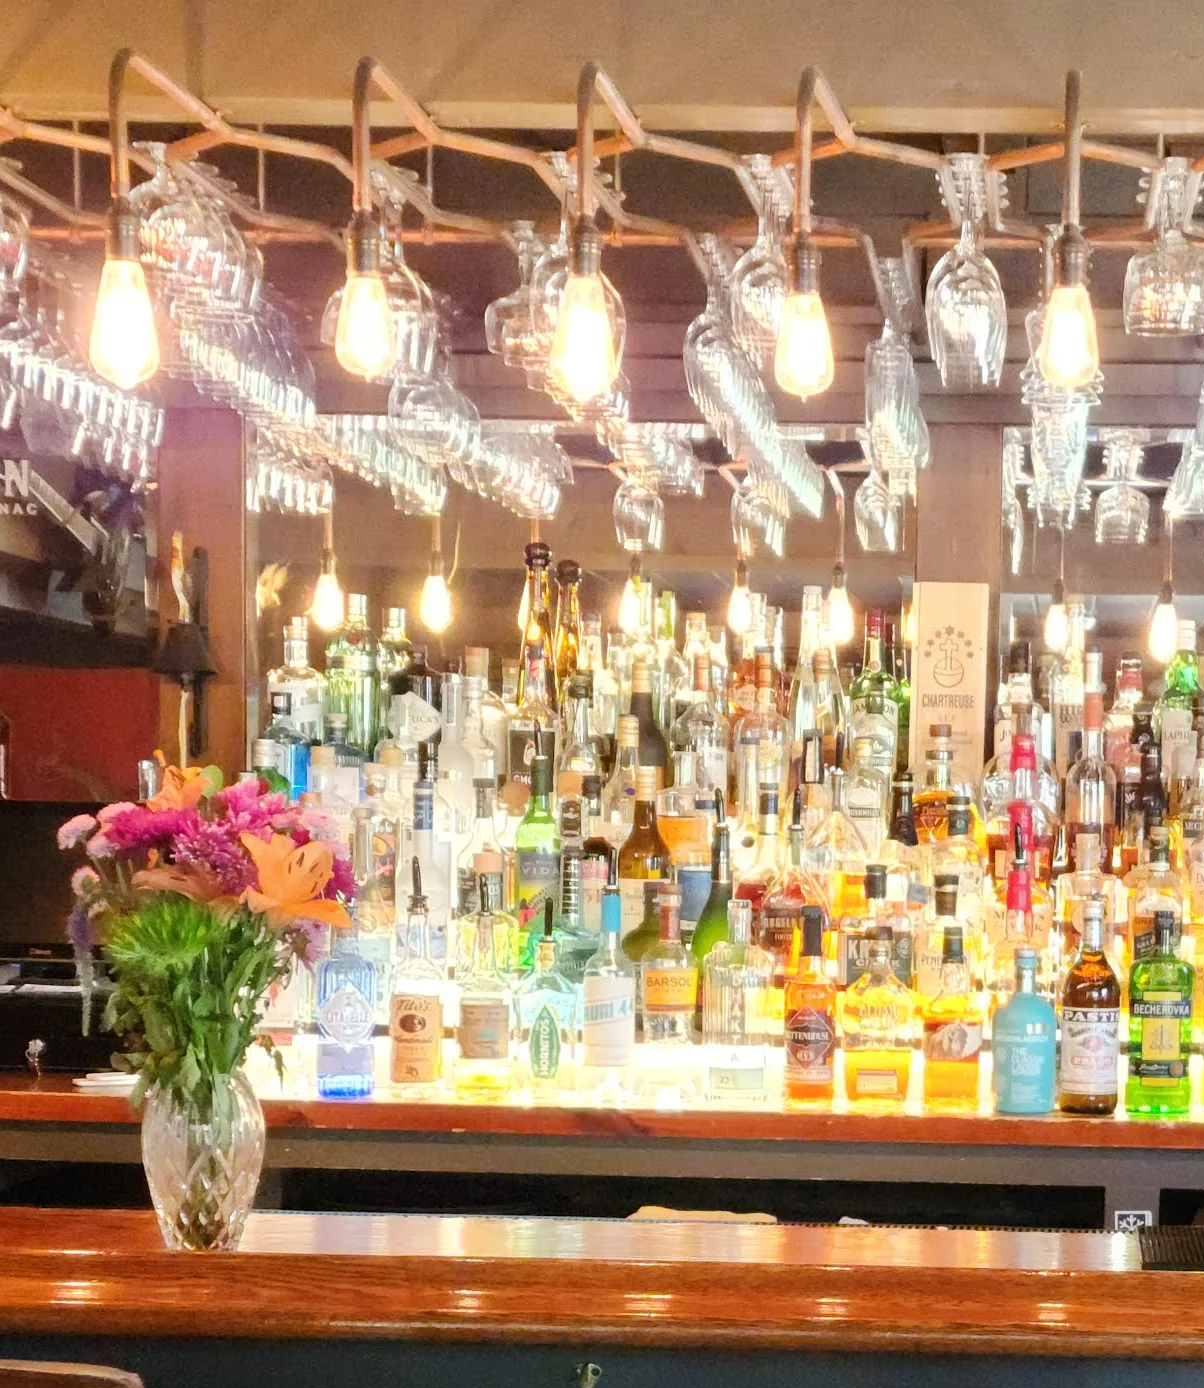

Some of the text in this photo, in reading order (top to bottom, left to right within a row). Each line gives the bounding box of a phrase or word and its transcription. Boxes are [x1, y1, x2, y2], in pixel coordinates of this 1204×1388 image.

[922, 694, 974, 709] CHARTREUSE
[521, 865, 560, 876] VIDA
[646, 976, 694, 988] BARSOL
[1133, 1003, 1190, 1016] BECHEROVKA
